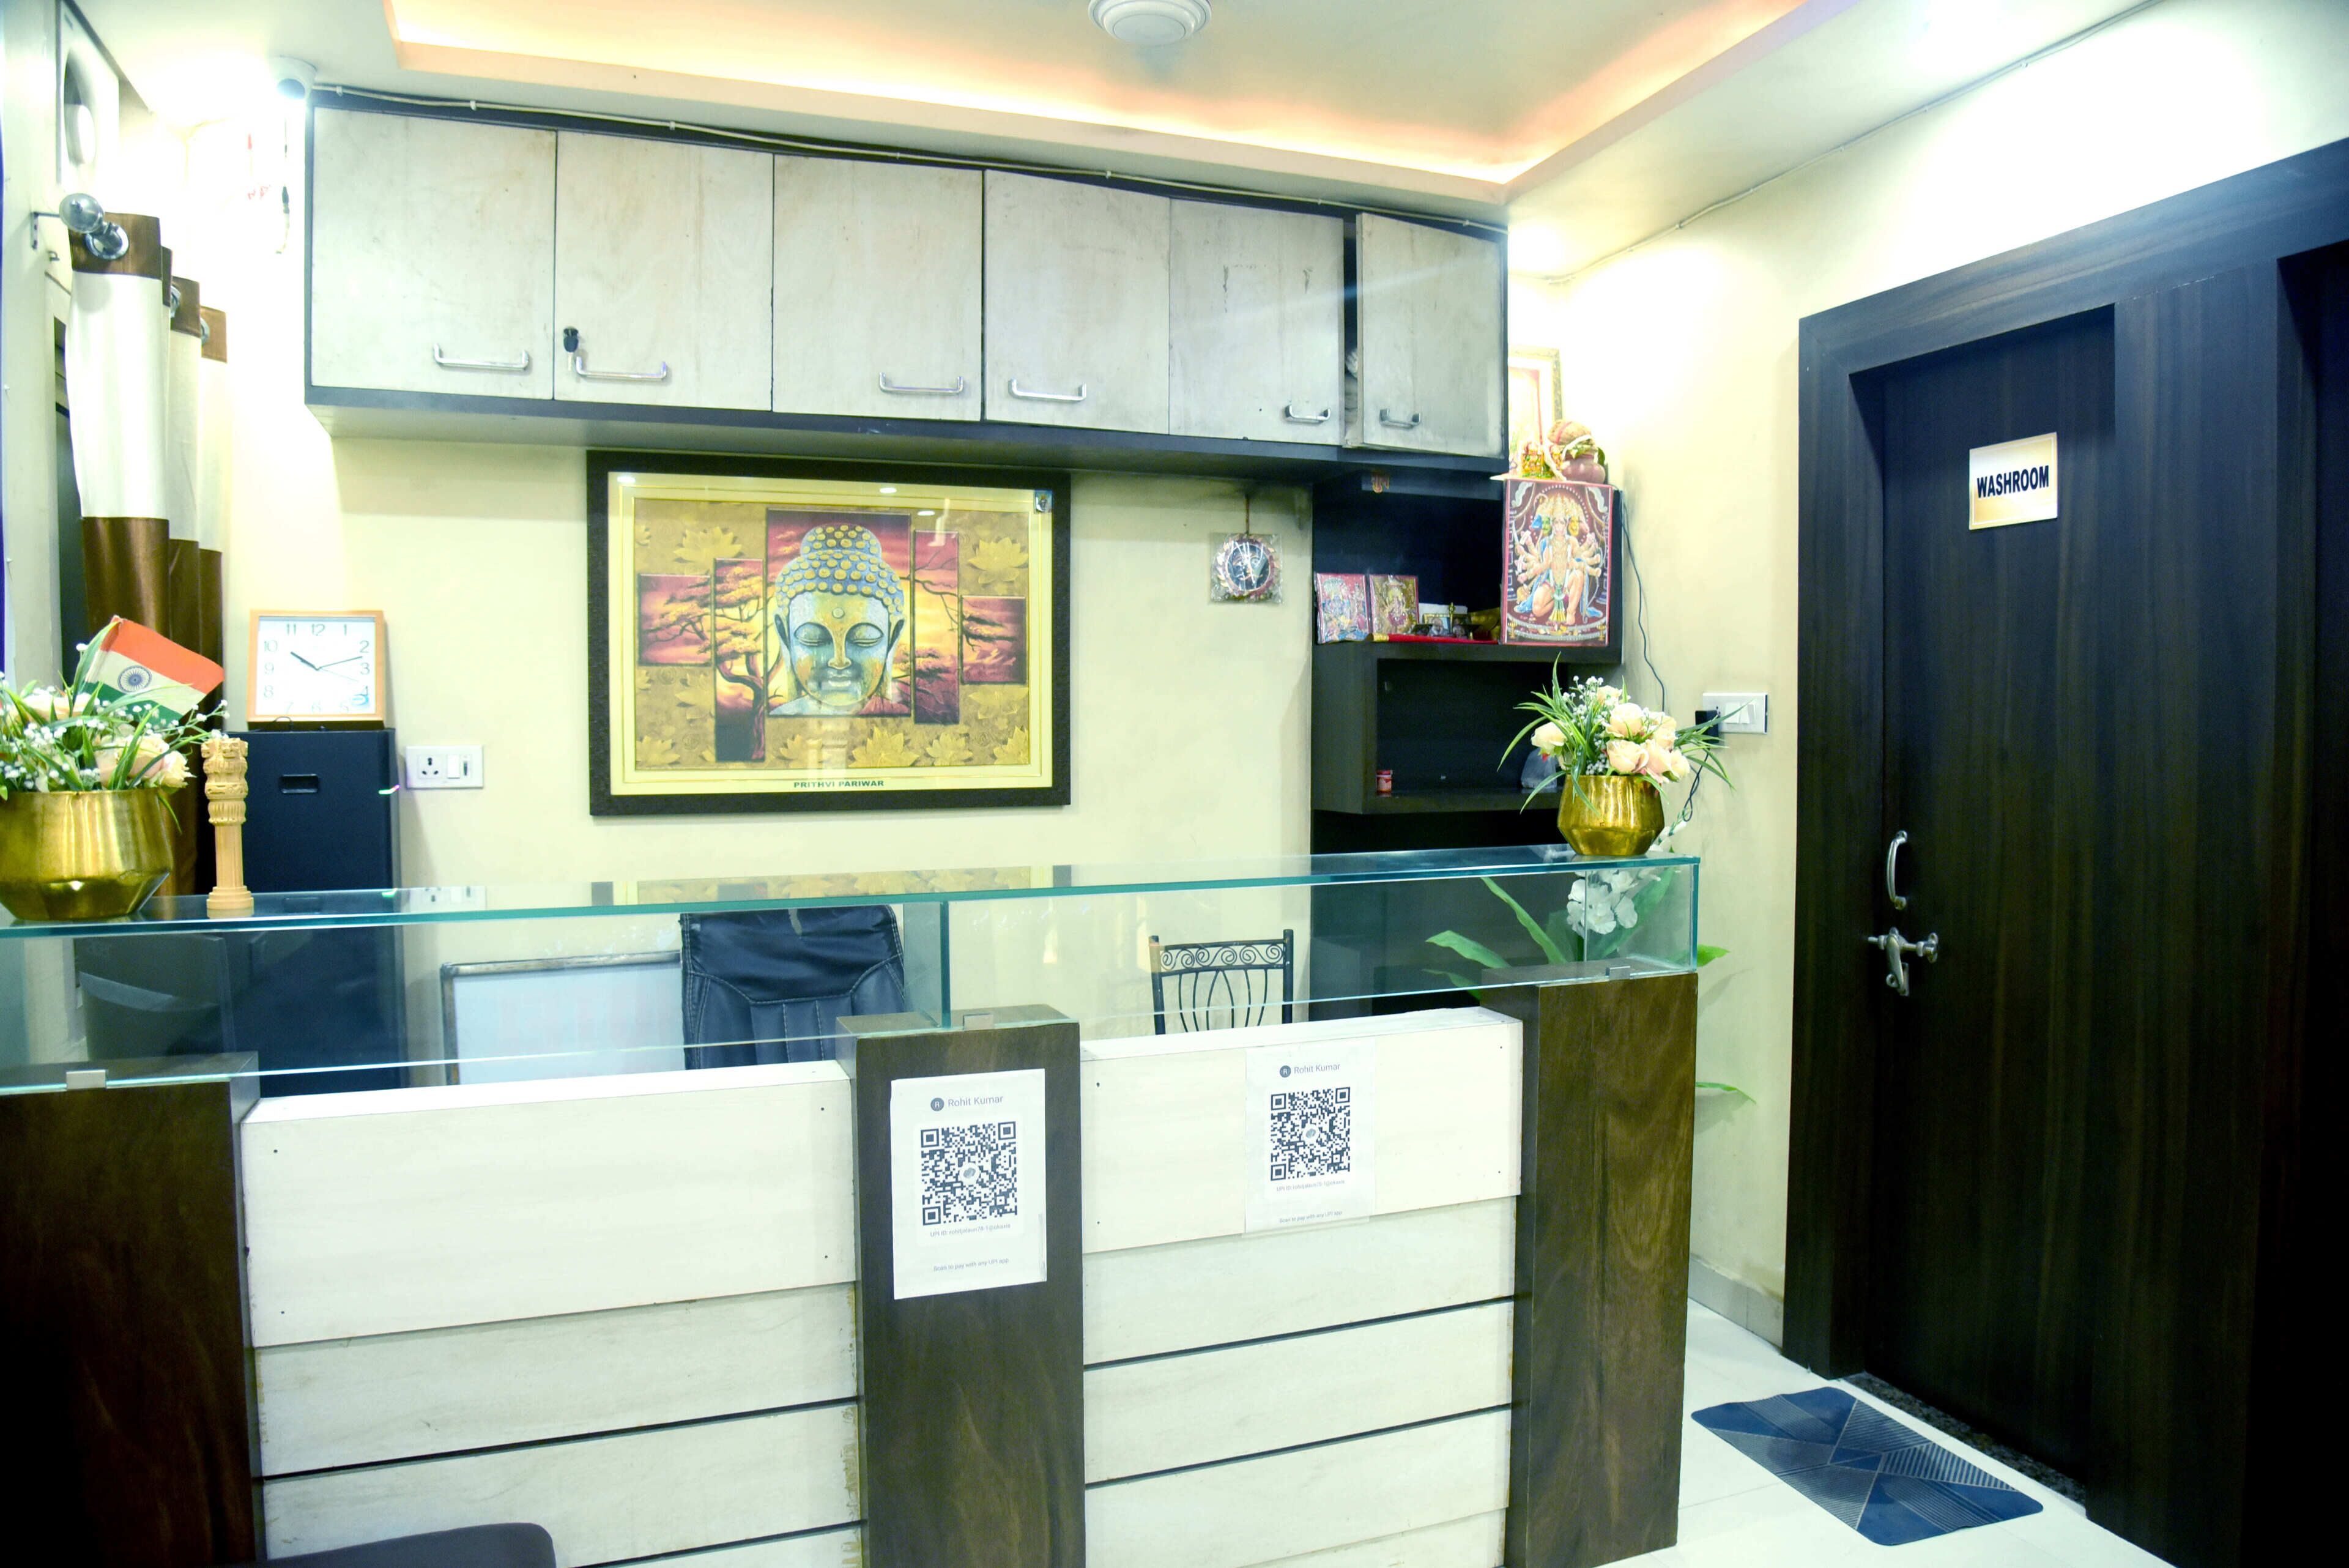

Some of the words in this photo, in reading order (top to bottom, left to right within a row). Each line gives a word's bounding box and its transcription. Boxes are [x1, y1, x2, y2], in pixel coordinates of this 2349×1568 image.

[1976, 465, 2049, 498] WASHROOM
[286, 623, 297, 636] 11
[311, 623, 325, 636] 12
[344, 624, 347, 636] 1
[264, 640, 278, 652] 10
[359, 640, 369, 653] 2
[264, 662, 274, 675] 9
[360, 662, 370, 675] 3
[264, 685, 274, 698] 8
[284, 701, 294, 714] 7
[312, 700, 321, 713] 6
[339, 701, 349, 713] 5
[1294, 1065, 1313, 1074] Rohit
[1315, 1063, 1340, 1072] Kumar
[948, 1098, 971, 1107] Rohit
[974, 1096, 1003, 1105] Kumar
